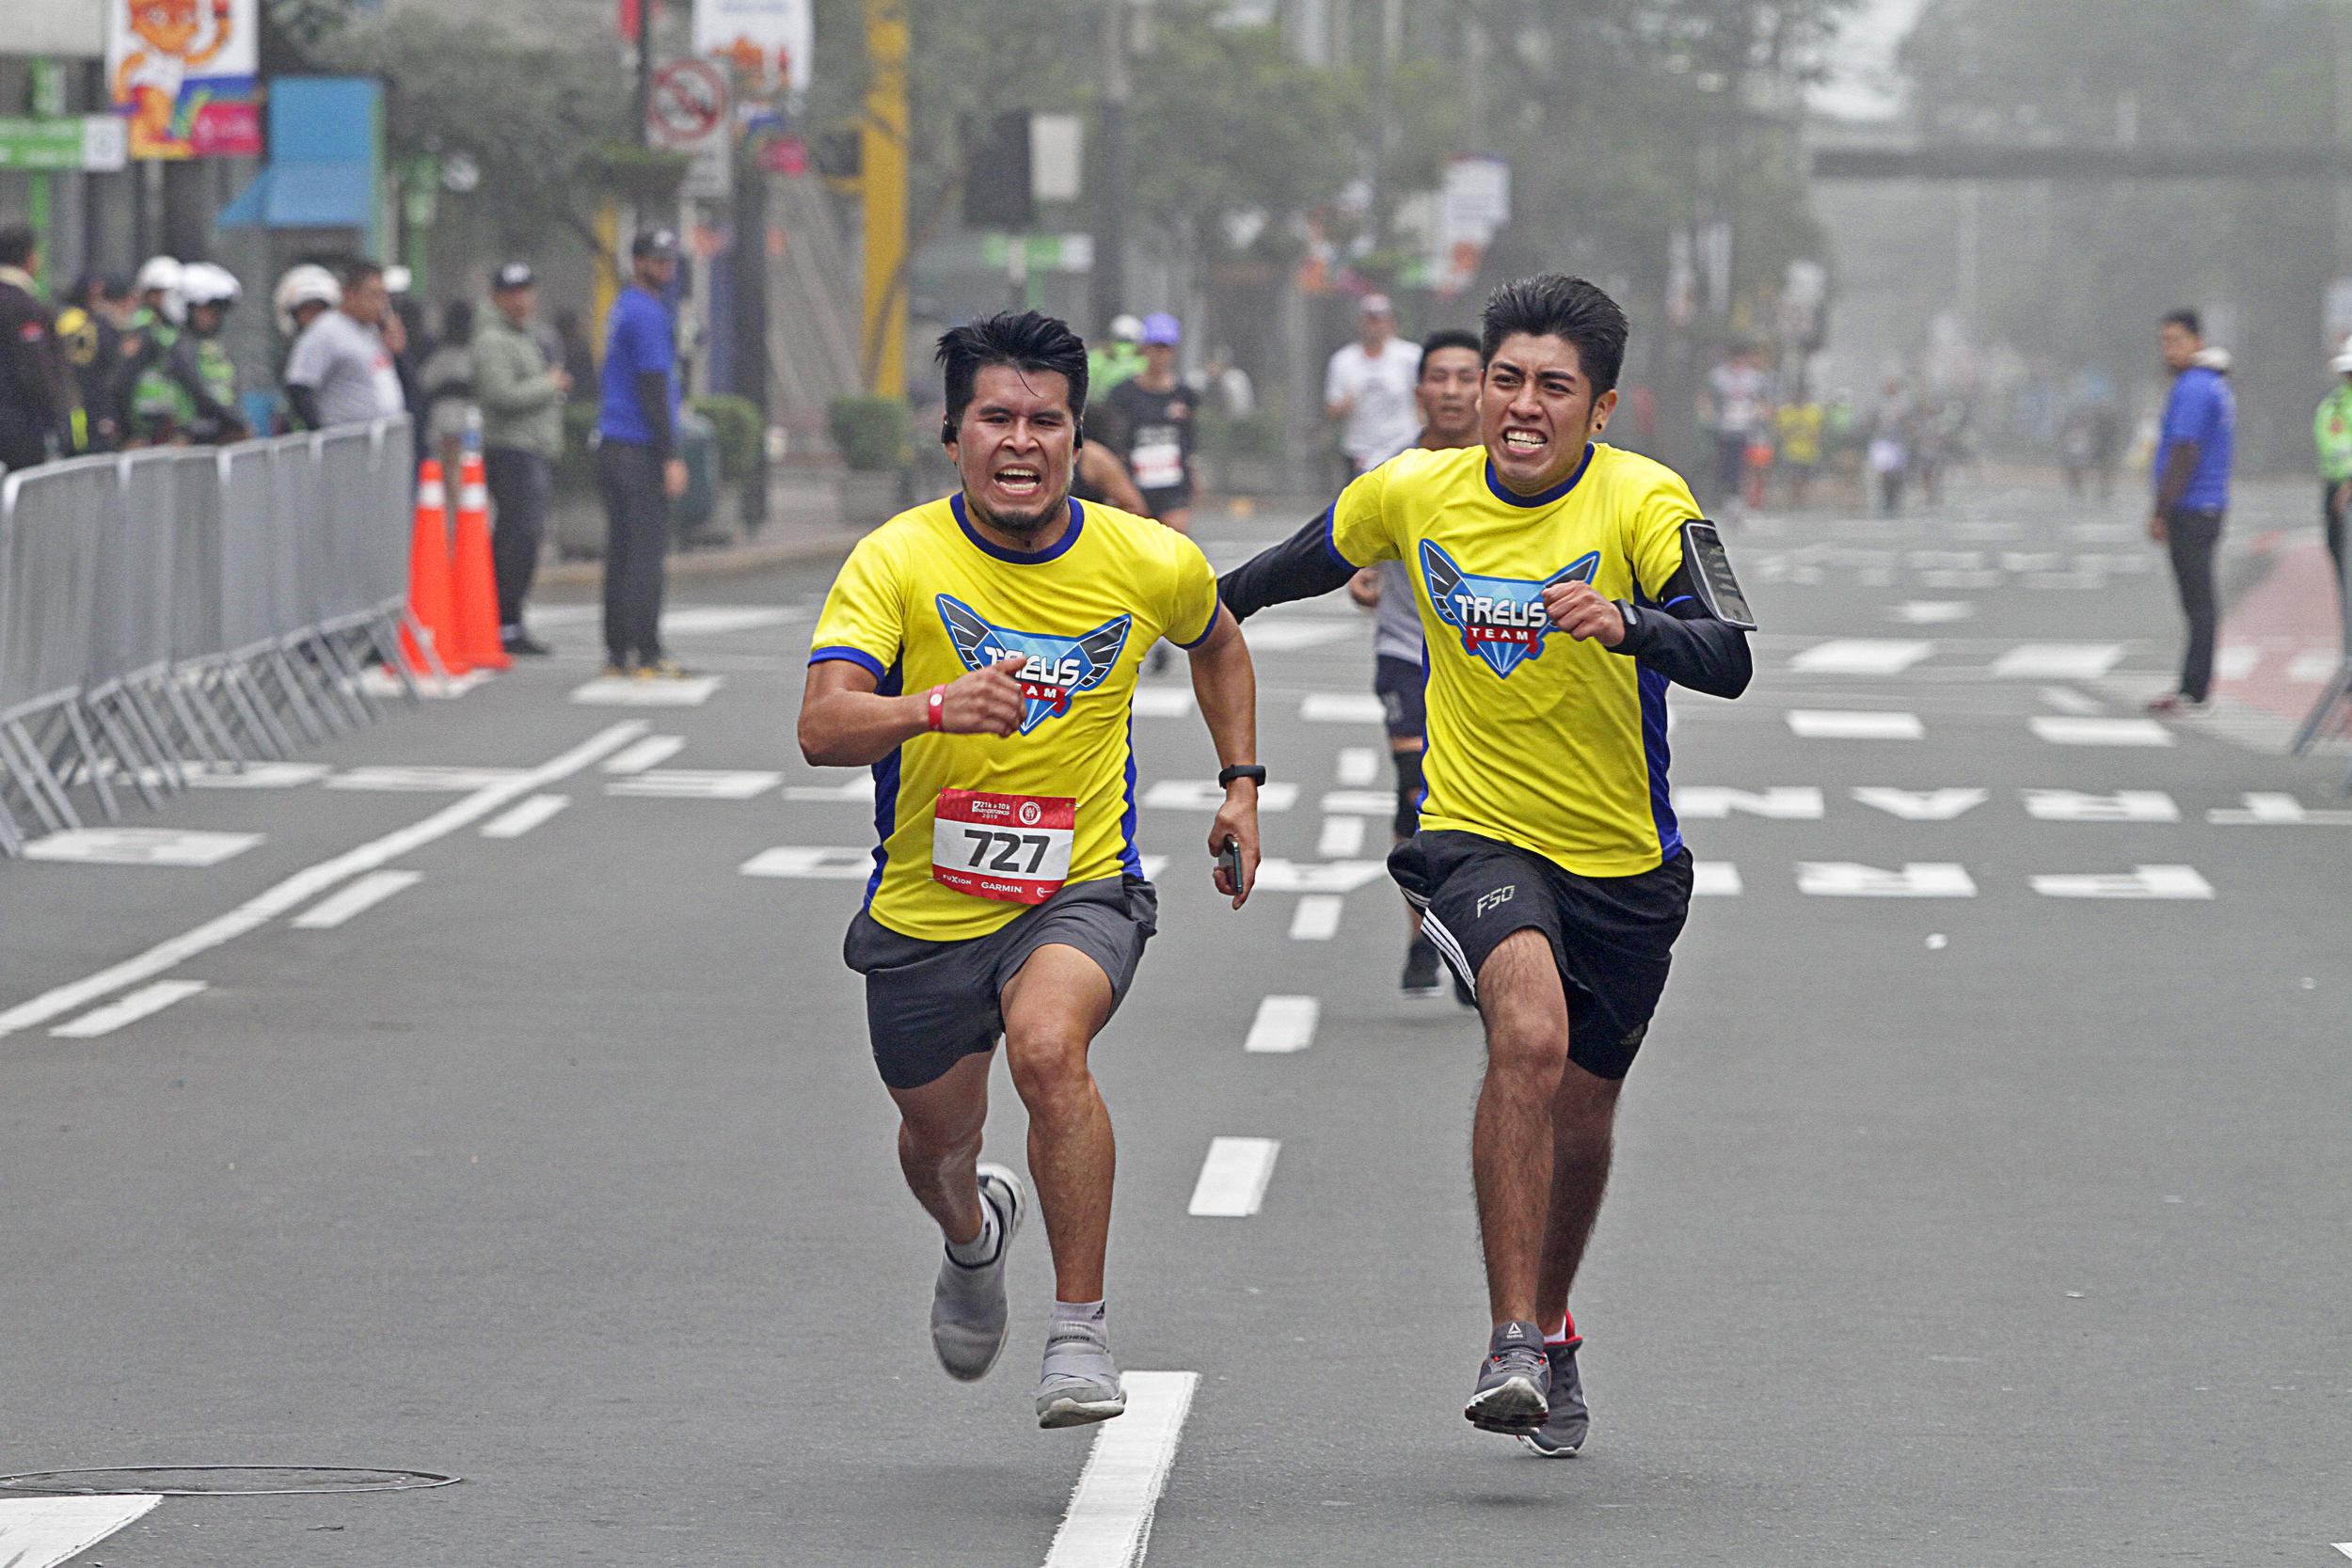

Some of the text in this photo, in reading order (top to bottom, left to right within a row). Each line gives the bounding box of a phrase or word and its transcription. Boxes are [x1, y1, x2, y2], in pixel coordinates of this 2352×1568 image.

[1454, 594, 1548, 628] TREUS
[1470, 627, 1529, 641] TEAM
[964, 829, 1051, 874] 727
[980, 881, 1023, 893] GARMIN
